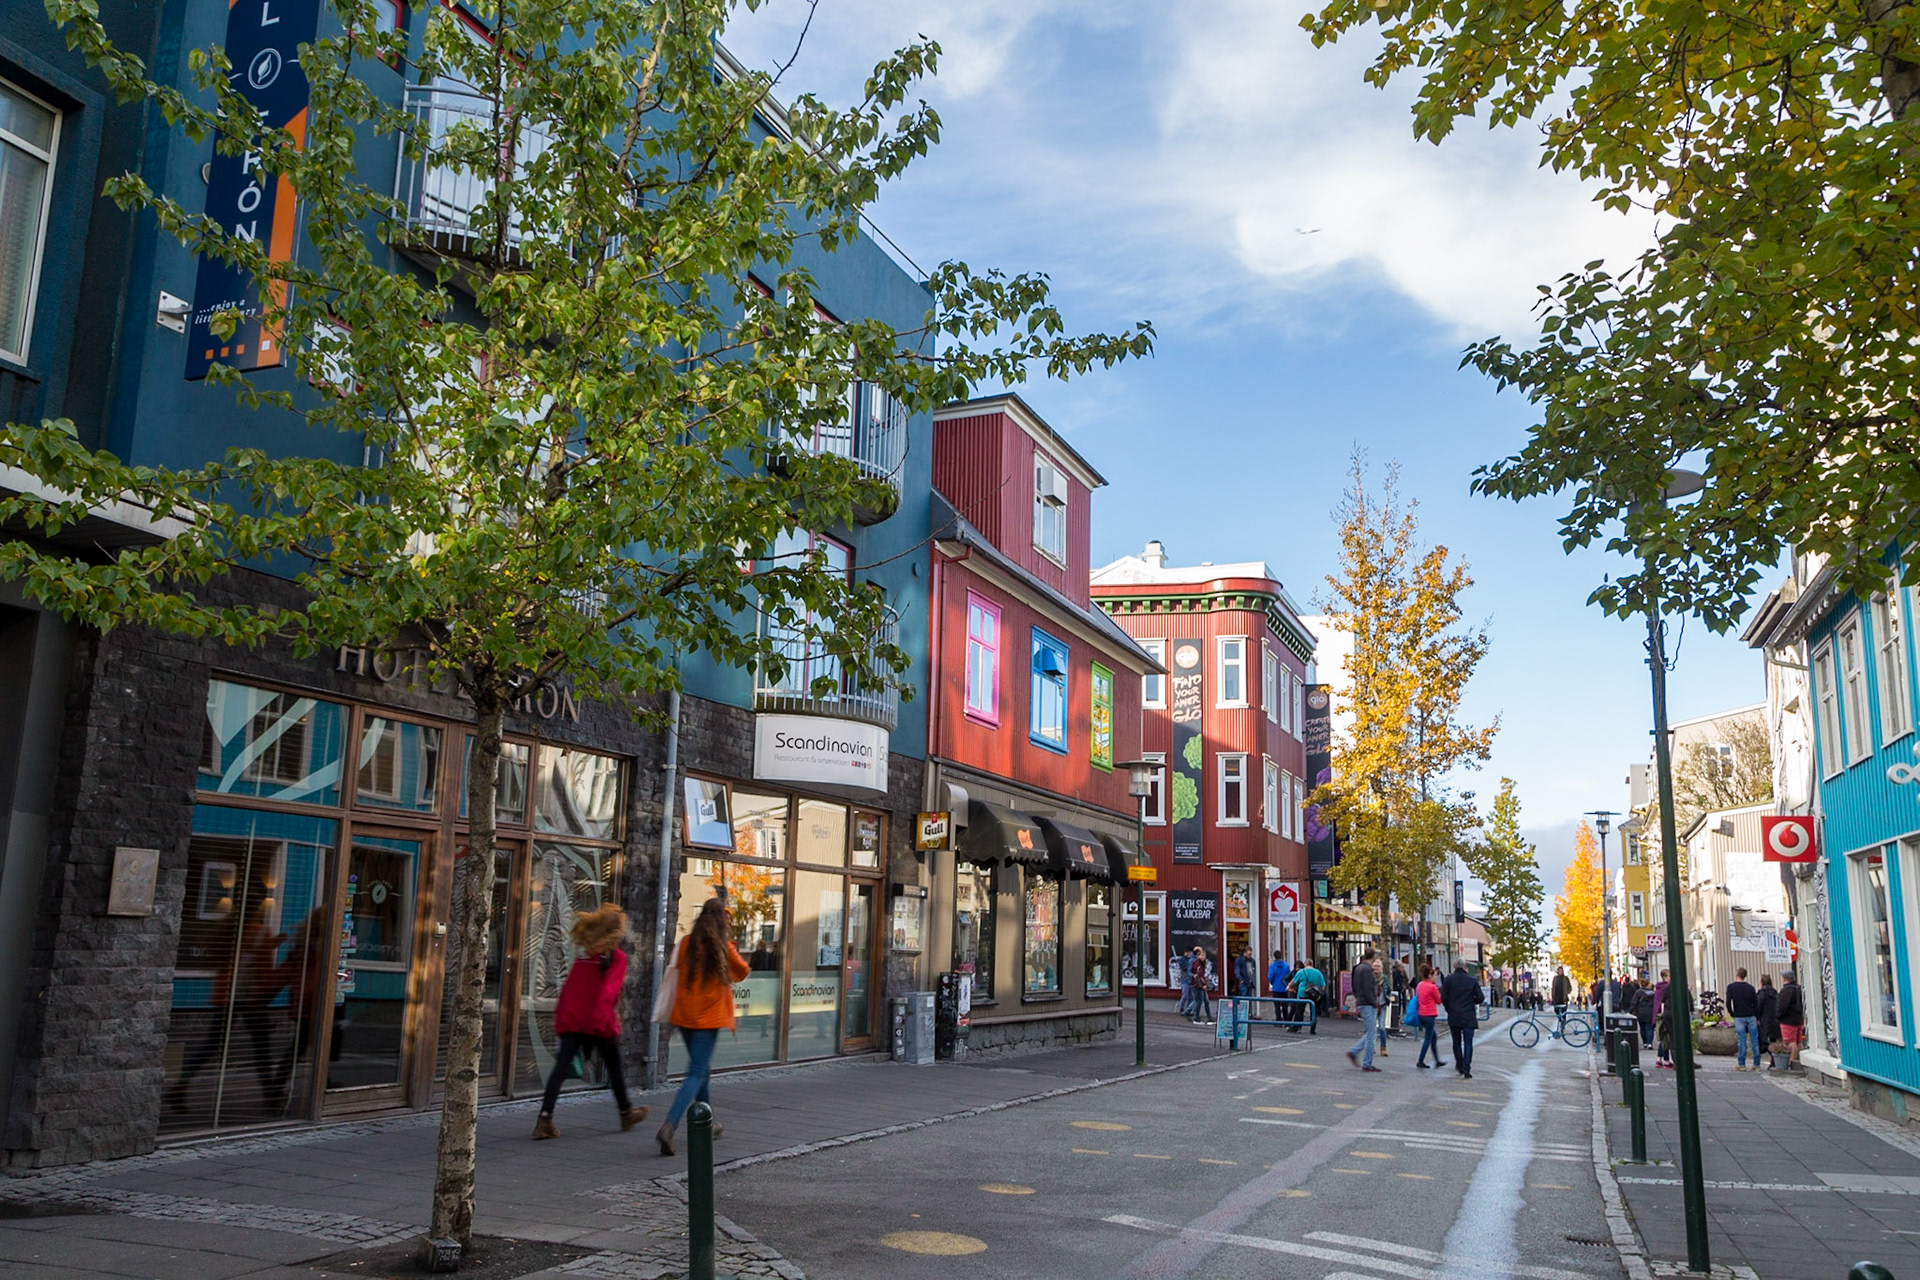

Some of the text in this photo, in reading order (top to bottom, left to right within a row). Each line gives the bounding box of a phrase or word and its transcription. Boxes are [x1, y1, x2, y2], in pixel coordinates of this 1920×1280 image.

[1175, 686, 1200, 698] YOUR
[775, 732, 873, 758] Scandinavian
[700, 803, 715, 817] Gull
[924, 823, 944, 836] Gull
[1171, 899, 1215, 909] HEALTH STORE
[1182, 909, 1211, 919] JUICEBAR
[792, 984, 835, 997] Scandinavian
